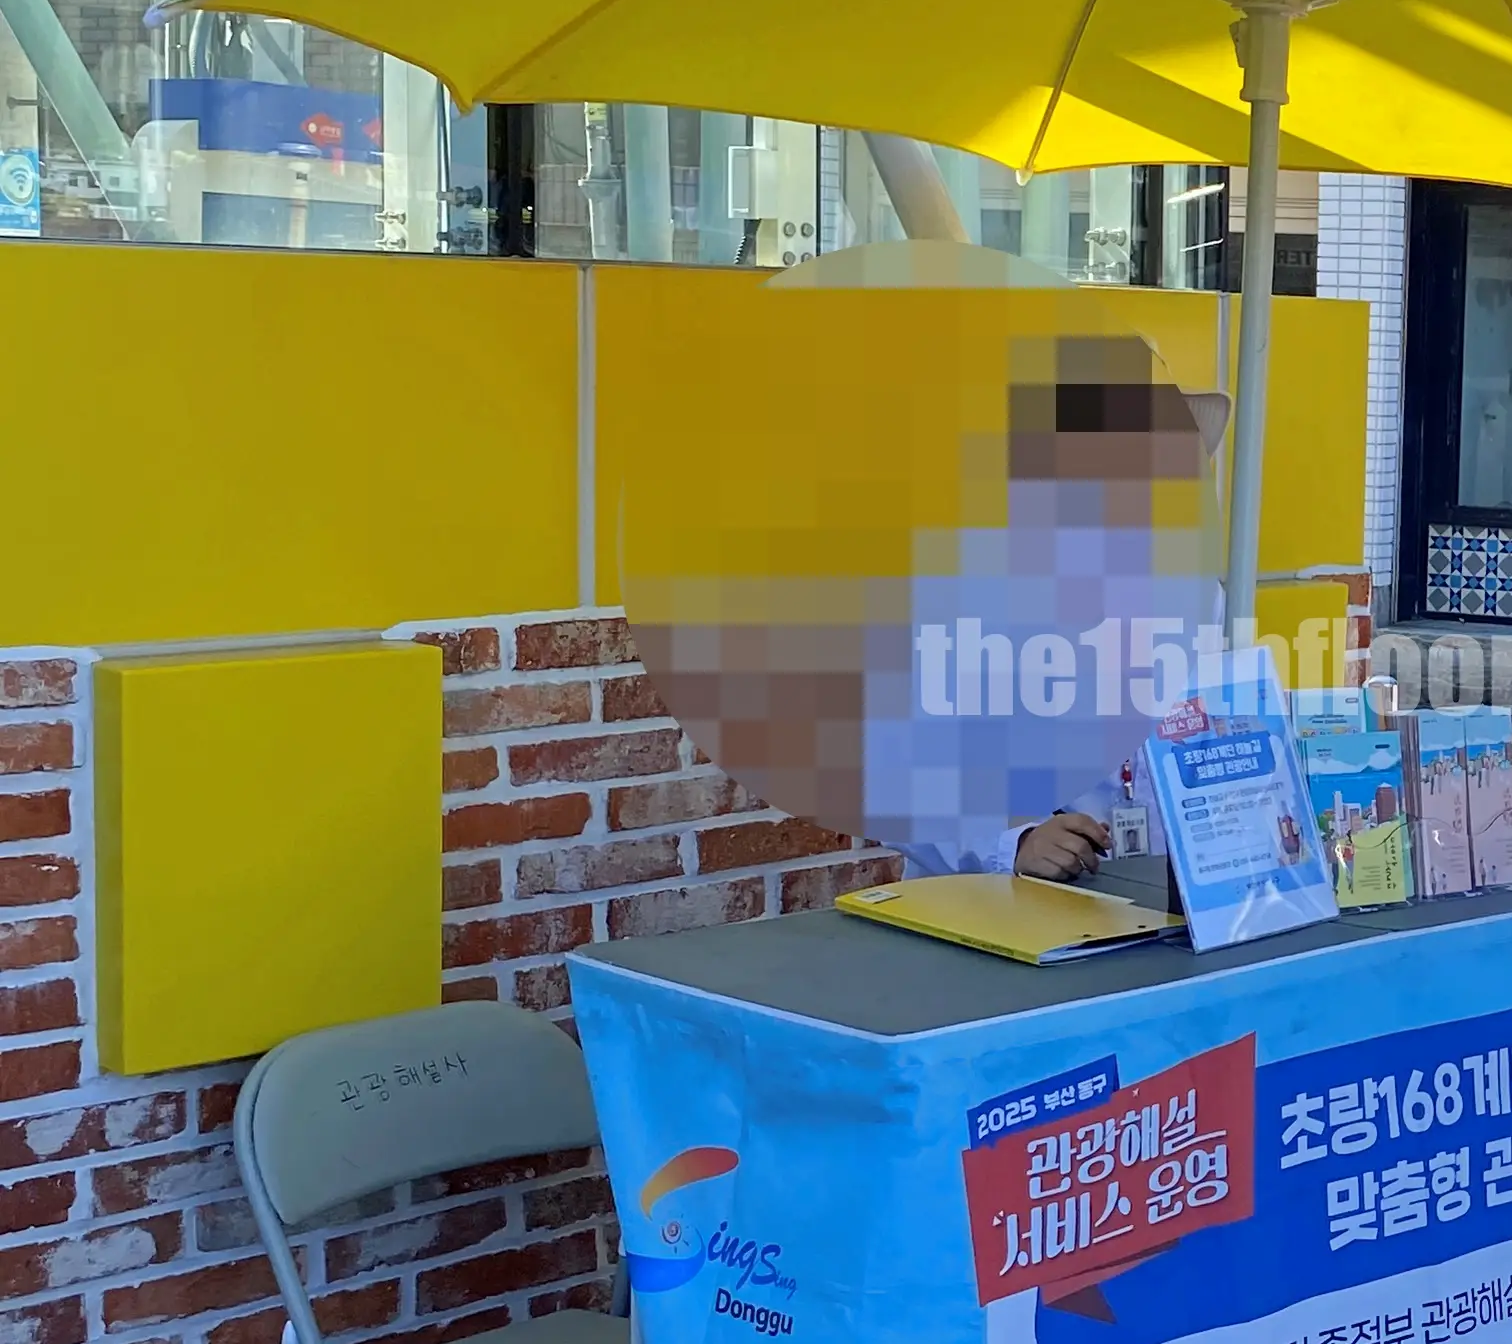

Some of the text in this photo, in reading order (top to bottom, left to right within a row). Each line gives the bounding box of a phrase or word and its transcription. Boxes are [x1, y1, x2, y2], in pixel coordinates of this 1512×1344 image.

[976, 1073, 1108, 1140] 2025 부산 동구
[1026, 1088, 1226, 1200] 관광해설
[998, 1143, 1229, 1277] 서비스 운영
[1326, 1146, 1472, 1252] 맞춤형
[714, 1286, 794, 1337] Donggu
